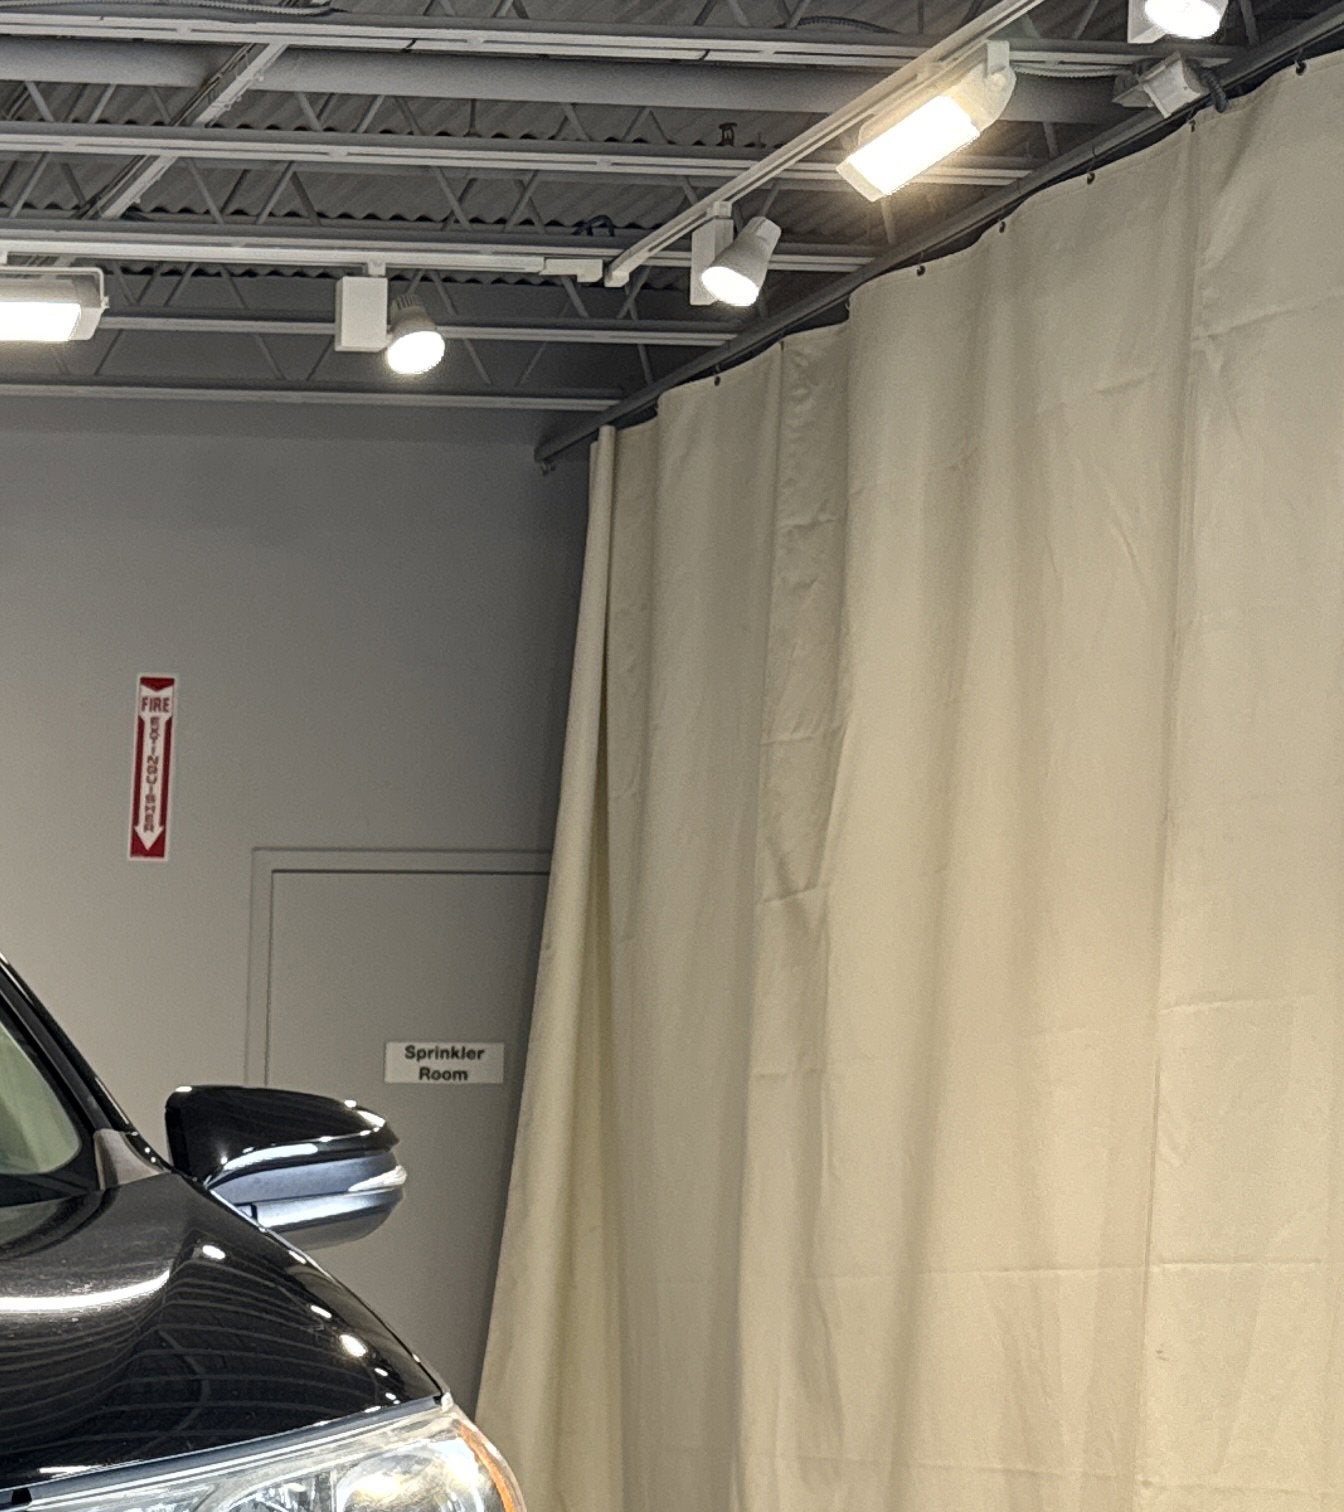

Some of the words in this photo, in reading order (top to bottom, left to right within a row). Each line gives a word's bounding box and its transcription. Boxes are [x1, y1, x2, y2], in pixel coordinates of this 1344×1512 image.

[141, 696, 171, 713] FIRE
[404, 1044, 485, 1062] Sprinkler
[418, 1066, 468, 1081] Room
